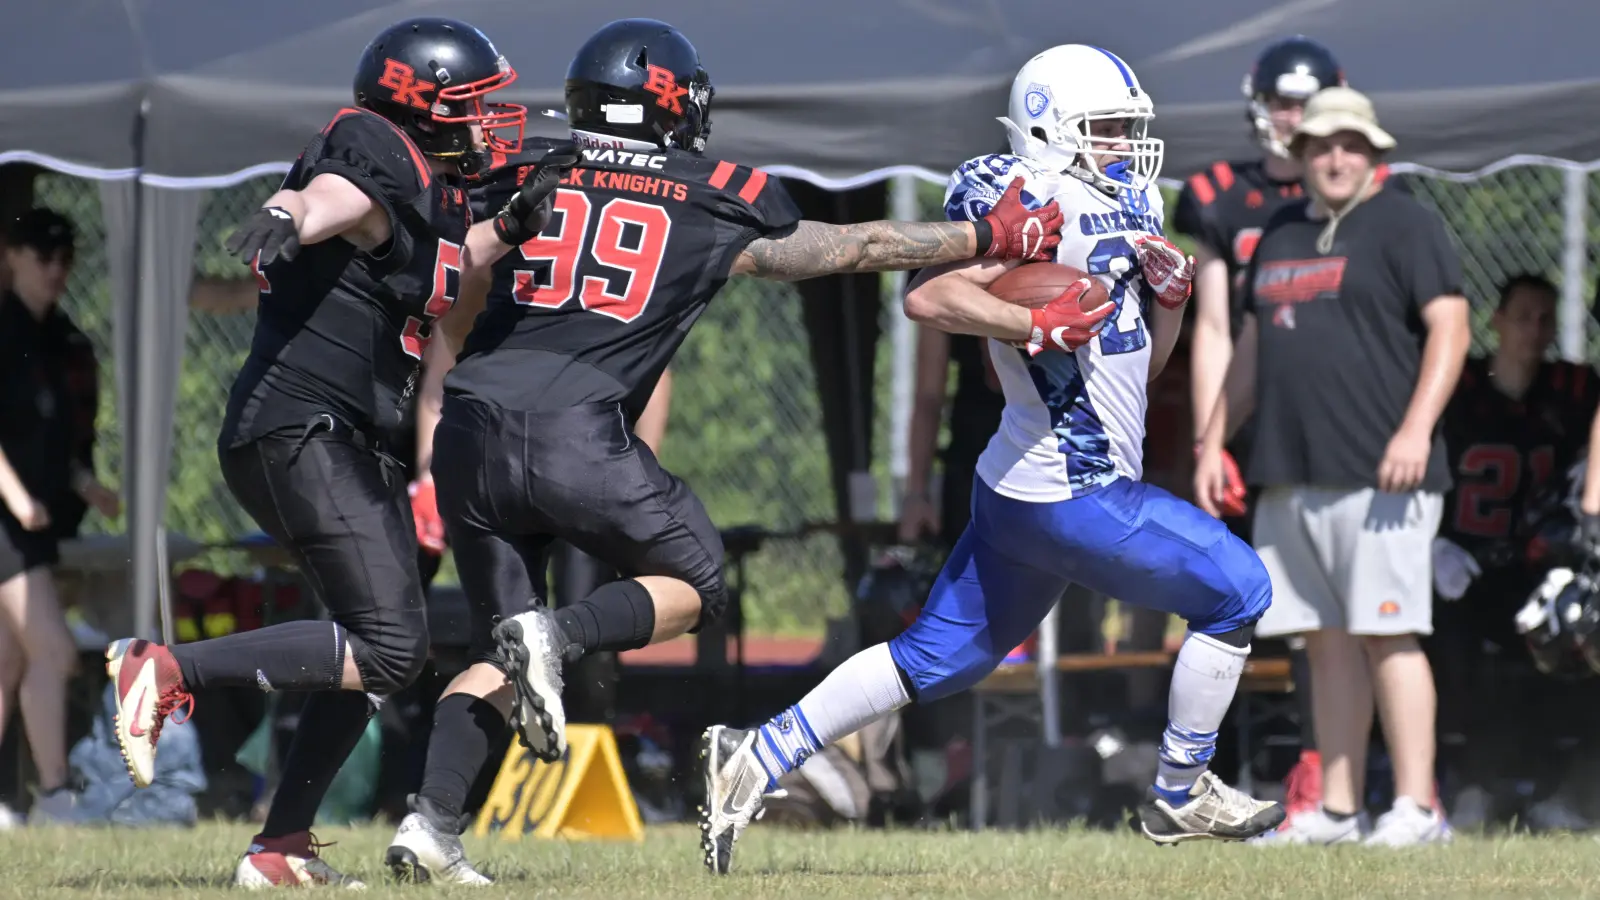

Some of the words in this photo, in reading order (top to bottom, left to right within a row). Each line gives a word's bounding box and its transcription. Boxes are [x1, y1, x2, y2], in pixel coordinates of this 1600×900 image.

[378, 57, 436, 110] BK
[643, 63, 689, 116] BK
[593, 171, 689, 202] KNIGHTS
[512, 187, 672, 323] 99
